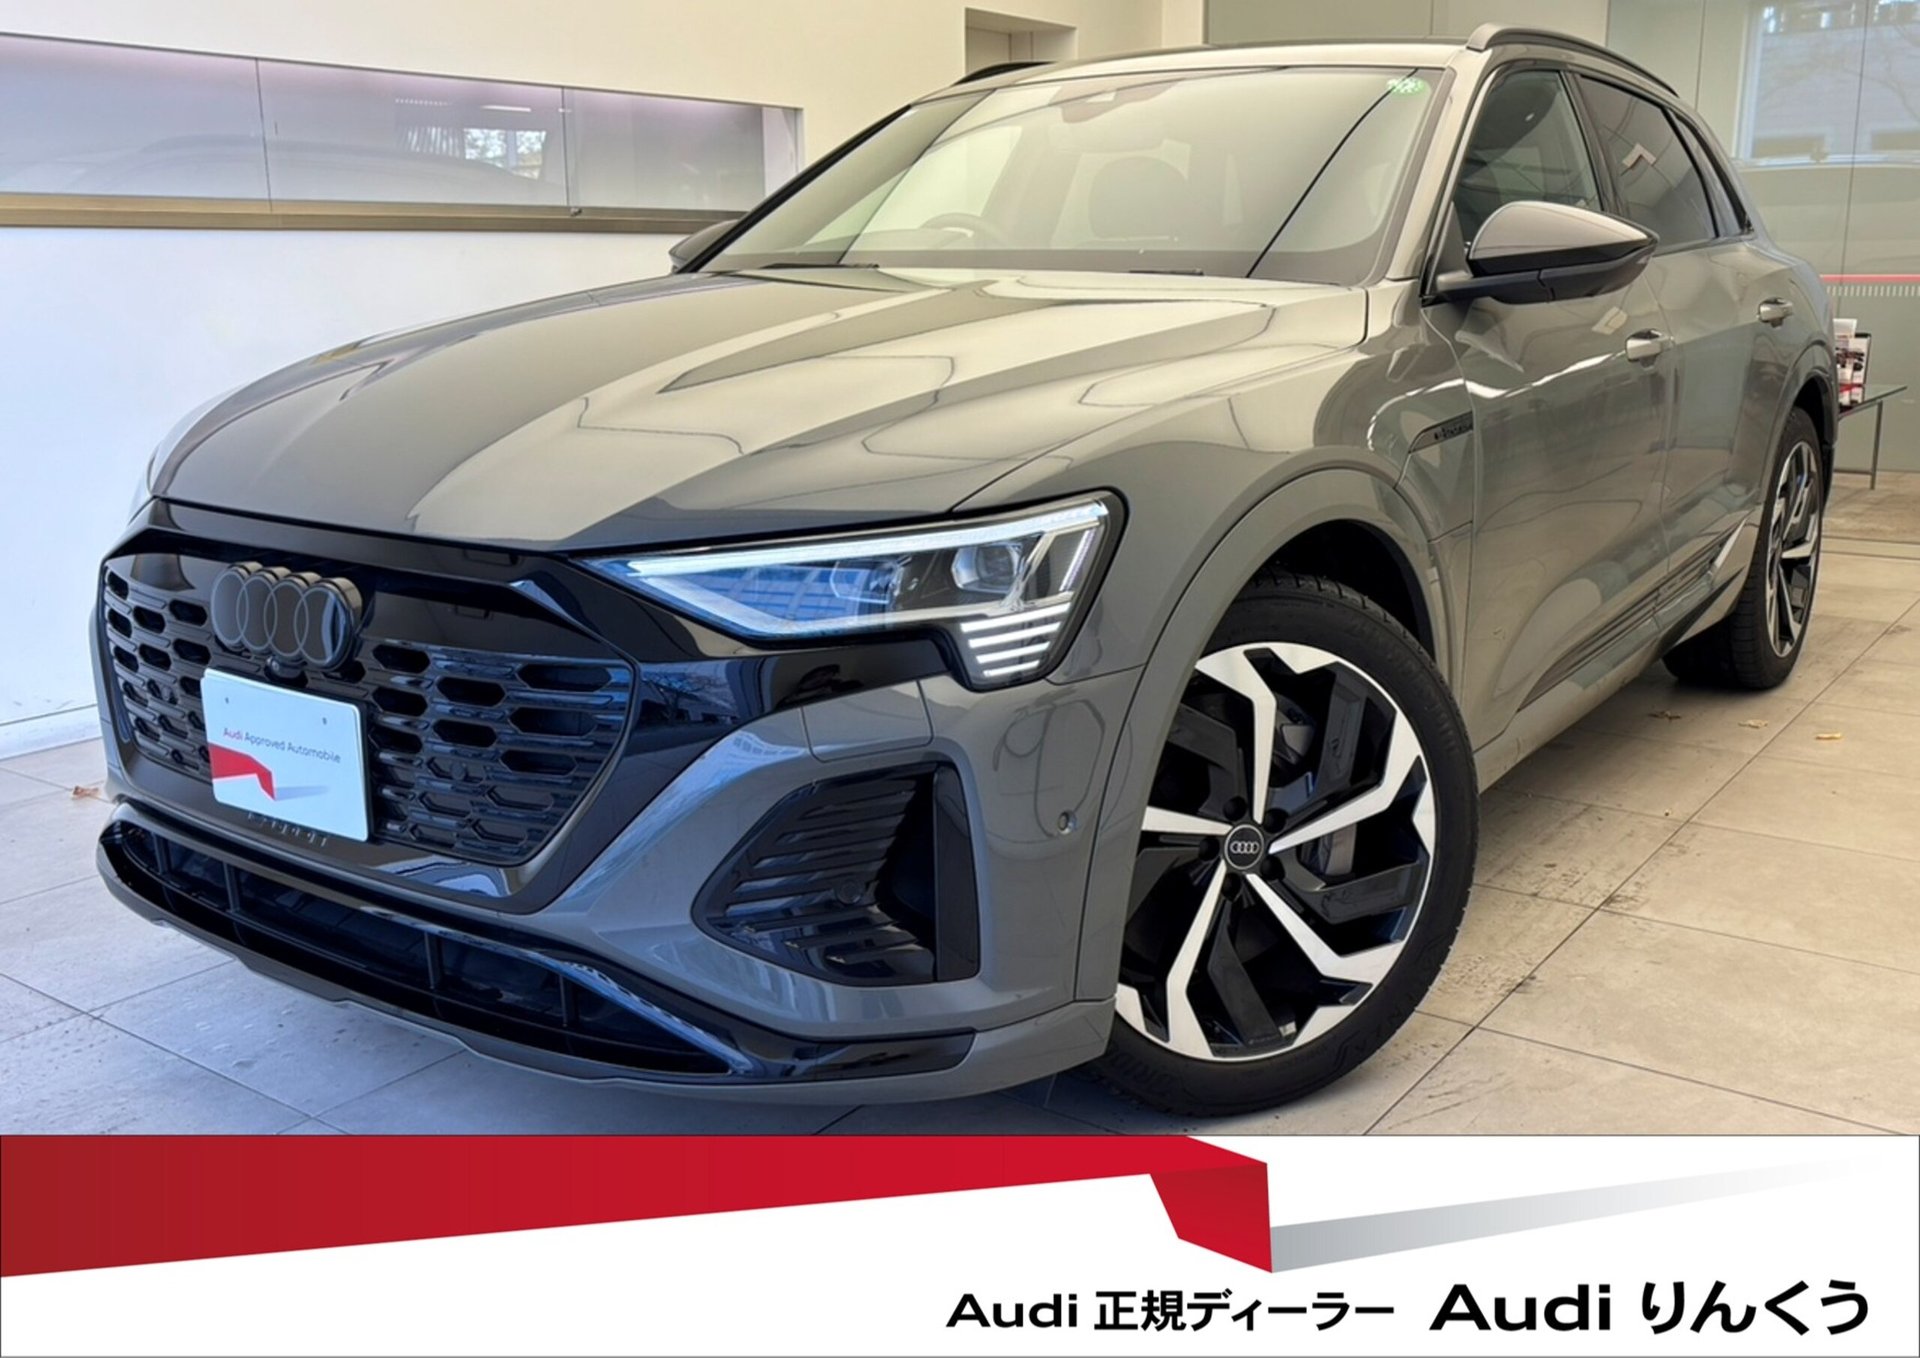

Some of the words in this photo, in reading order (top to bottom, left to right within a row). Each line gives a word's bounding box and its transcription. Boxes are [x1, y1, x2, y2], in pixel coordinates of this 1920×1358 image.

[223, 727, 244, 741] Audi
[244, 731, 286, 752] Approved
[287, 741, 341, 763] Automobile
